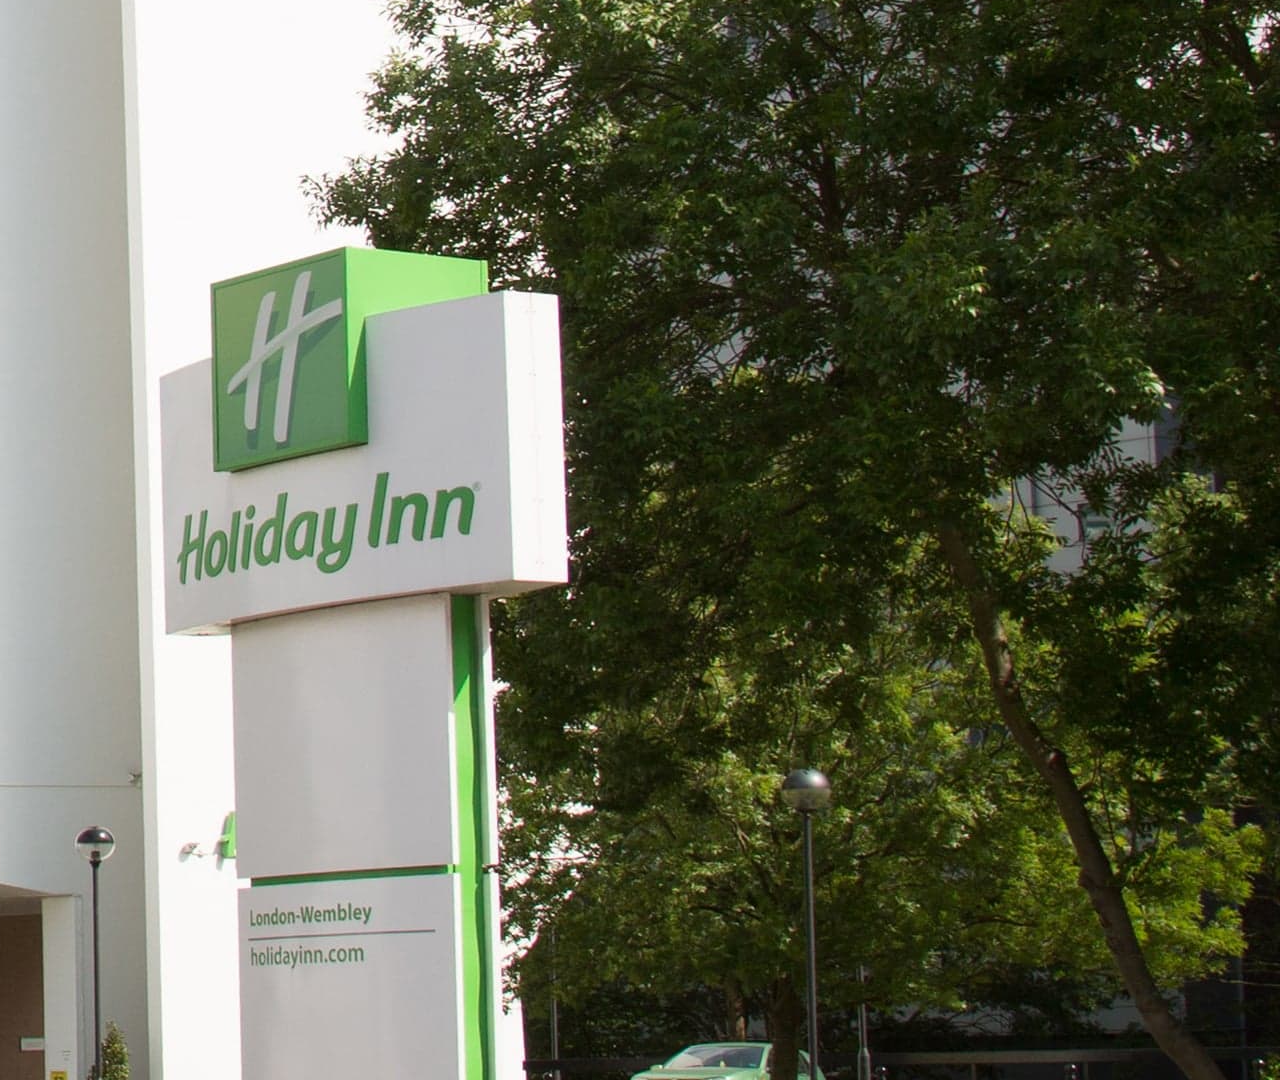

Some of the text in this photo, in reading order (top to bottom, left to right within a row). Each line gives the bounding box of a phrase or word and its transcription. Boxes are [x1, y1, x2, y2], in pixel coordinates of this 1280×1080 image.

[177, 472, 476, 584] Holiday Inn
[249, 903, 373, 927] London-Wembley
[250, 945, 364, 969] holidayinn.com
